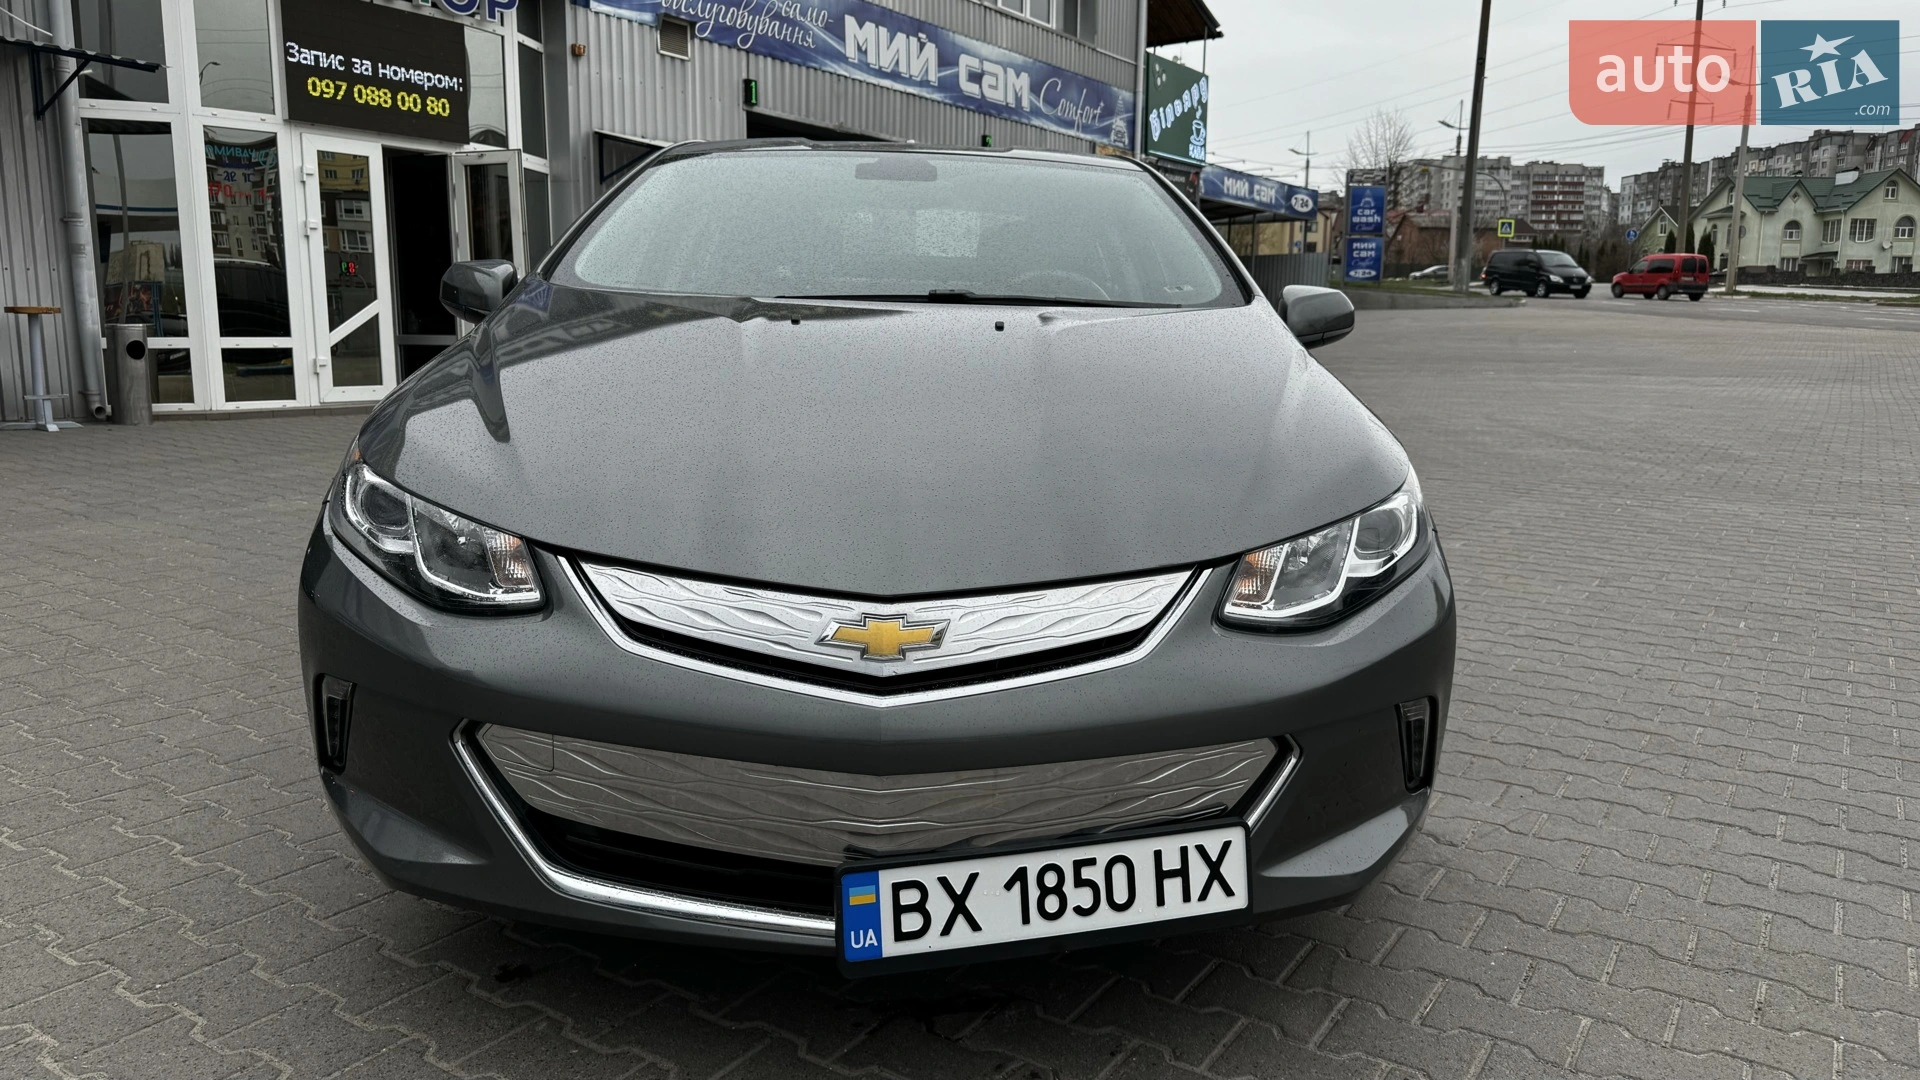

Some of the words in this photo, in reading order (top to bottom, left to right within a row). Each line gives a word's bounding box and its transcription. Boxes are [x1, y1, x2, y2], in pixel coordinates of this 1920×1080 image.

[286, 41, 345, 71] Запис
[351, 57, 373, 76] за
[378, 63, 463, 92] номером:
[844, 14, 938, 86] МИЙ
[1039, 77, 1104, 132] Comfort
[307, 76, 347, 100] 097
[353, 84, 392, 108] 088
[396, 91, 422, 112] 00
[426, 96, 450, 117] 80
[750, 81, 757, 104] 1
[1352, 214, 1381, 223] wash
[1357, 208, 1376, 216] car
[1003, 854, 1136, 925] 1850
[850, 928, 878, 949] UA
